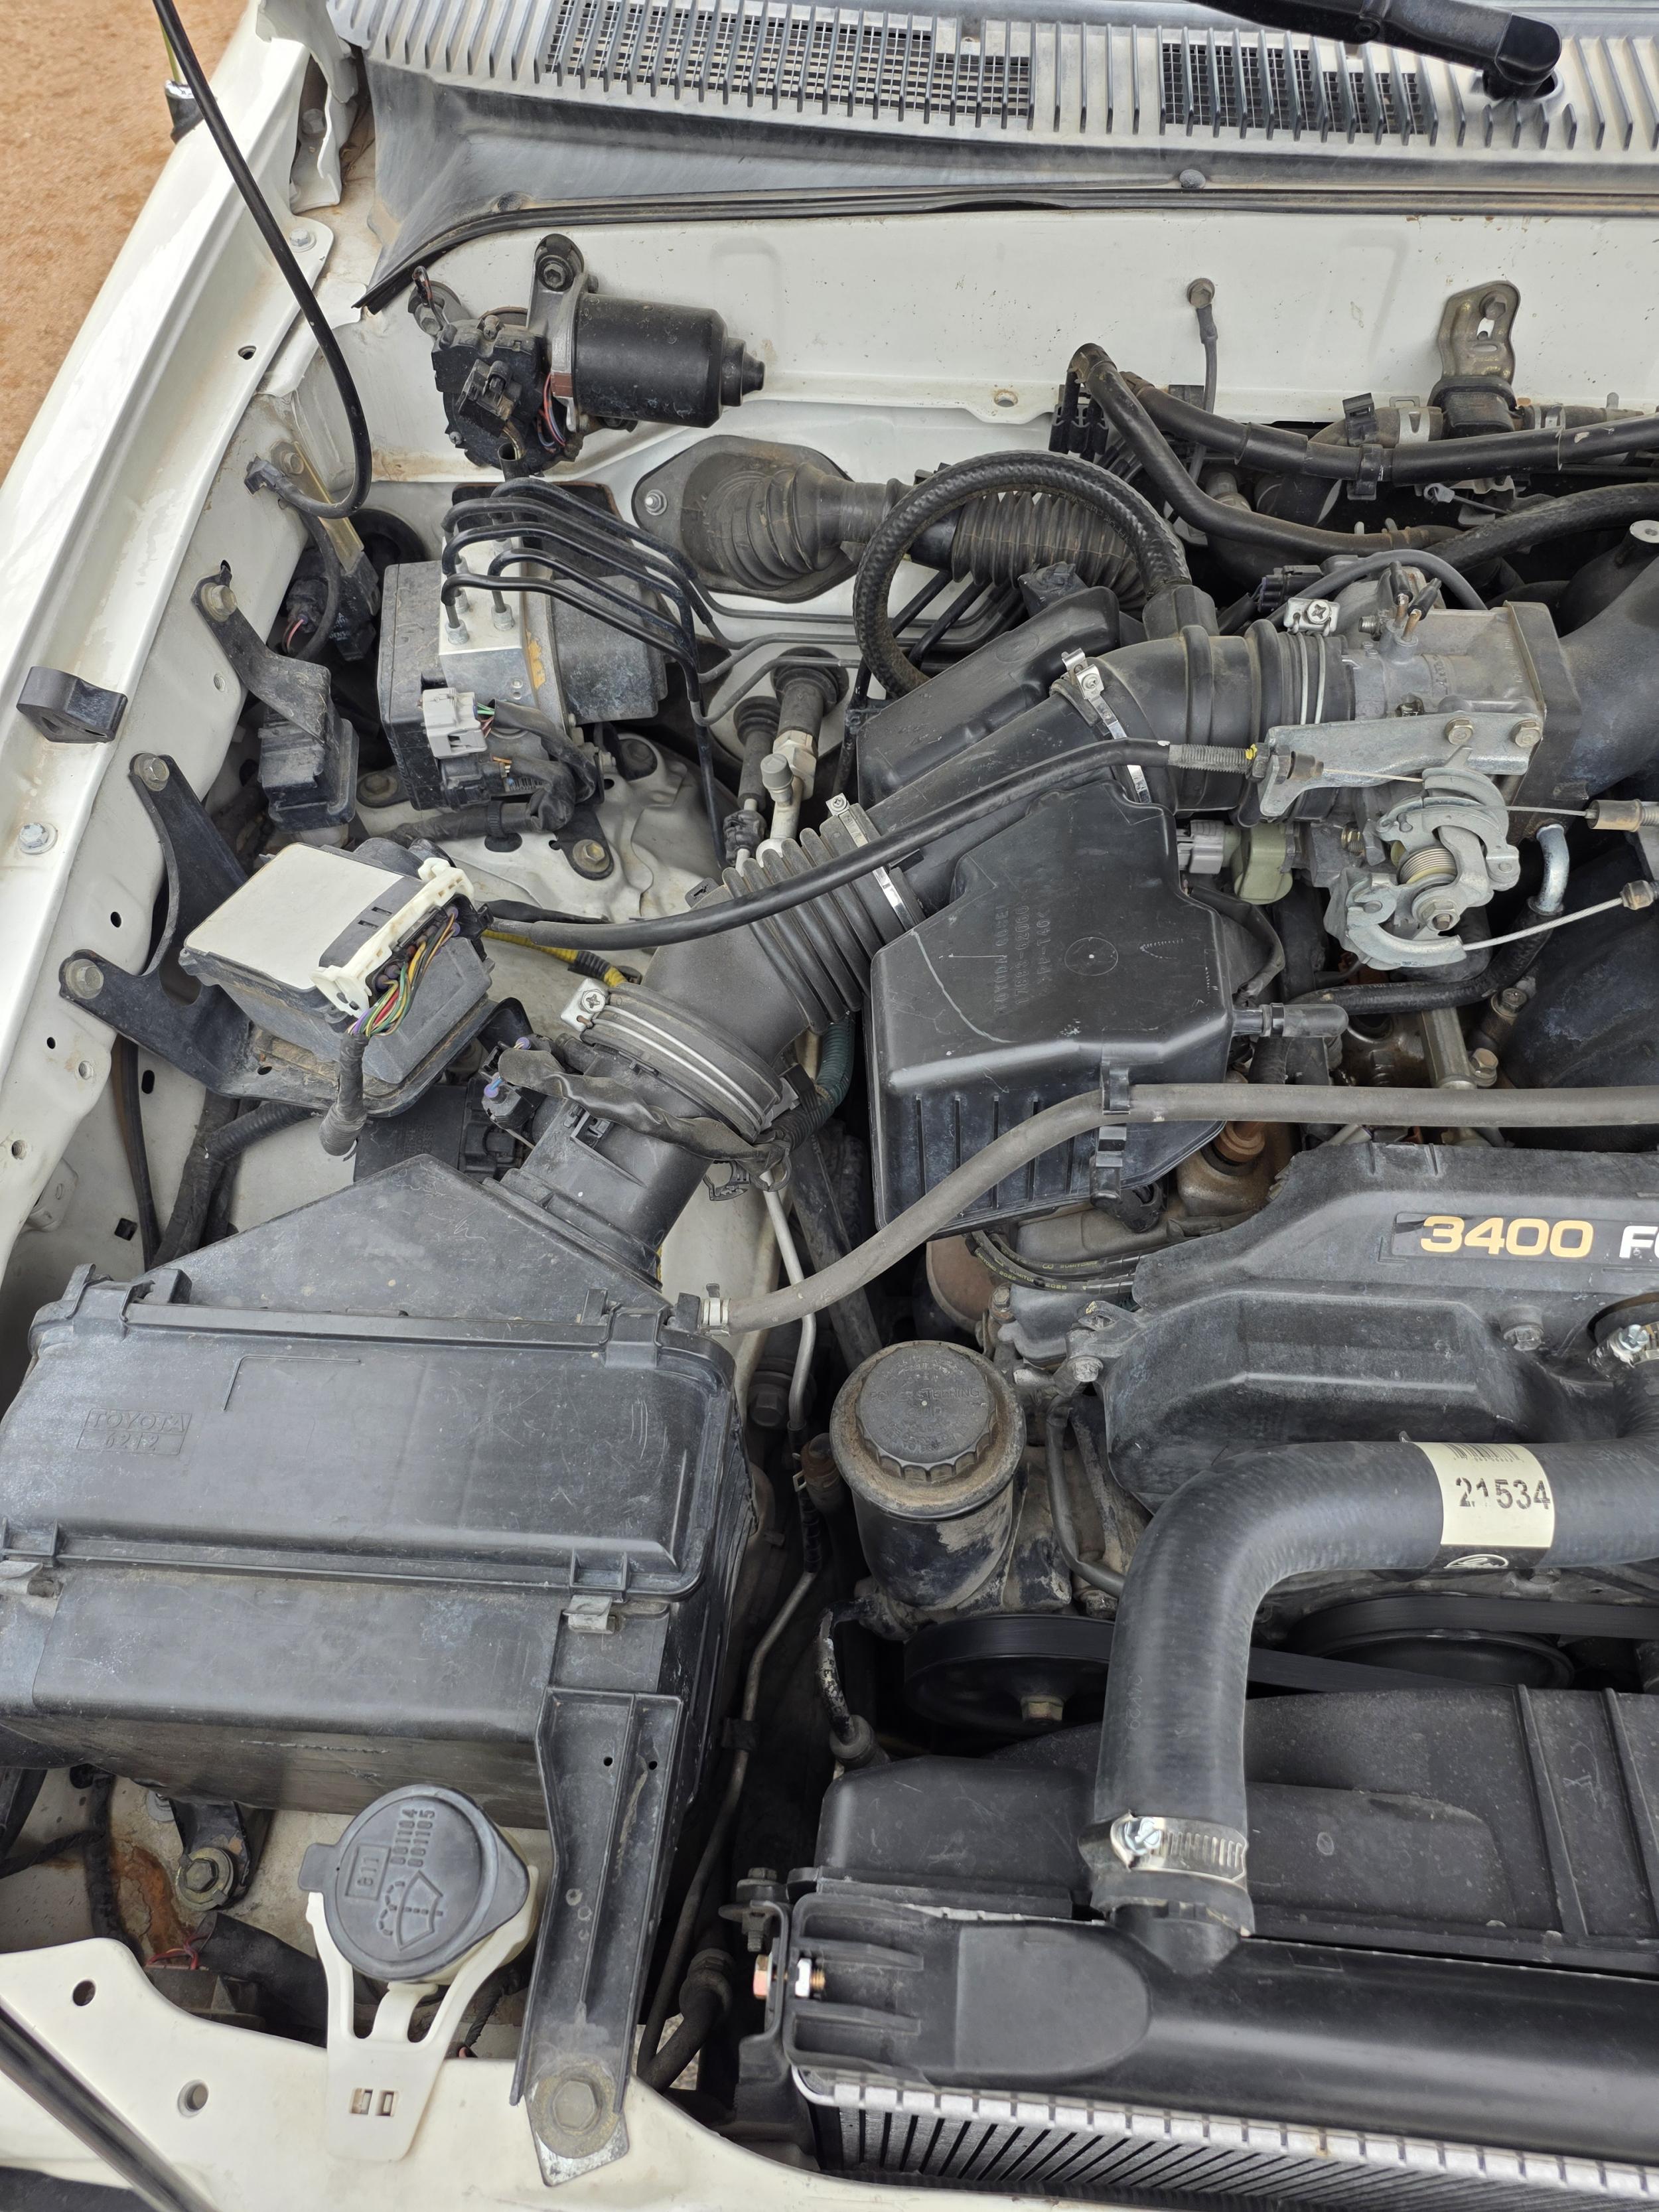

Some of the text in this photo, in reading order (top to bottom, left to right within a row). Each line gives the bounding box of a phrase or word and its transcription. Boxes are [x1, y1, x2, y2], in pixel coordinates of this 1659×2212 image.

[1420, 1215, 1659, 1259] 3400 F
[92, 1412, 184, 1432] TOYOTA
[1455, 1477, 1551, 1510] 21534
[390, 1809, 418, 1865] 001104
[407, 1810, 435, 1867] 001105
